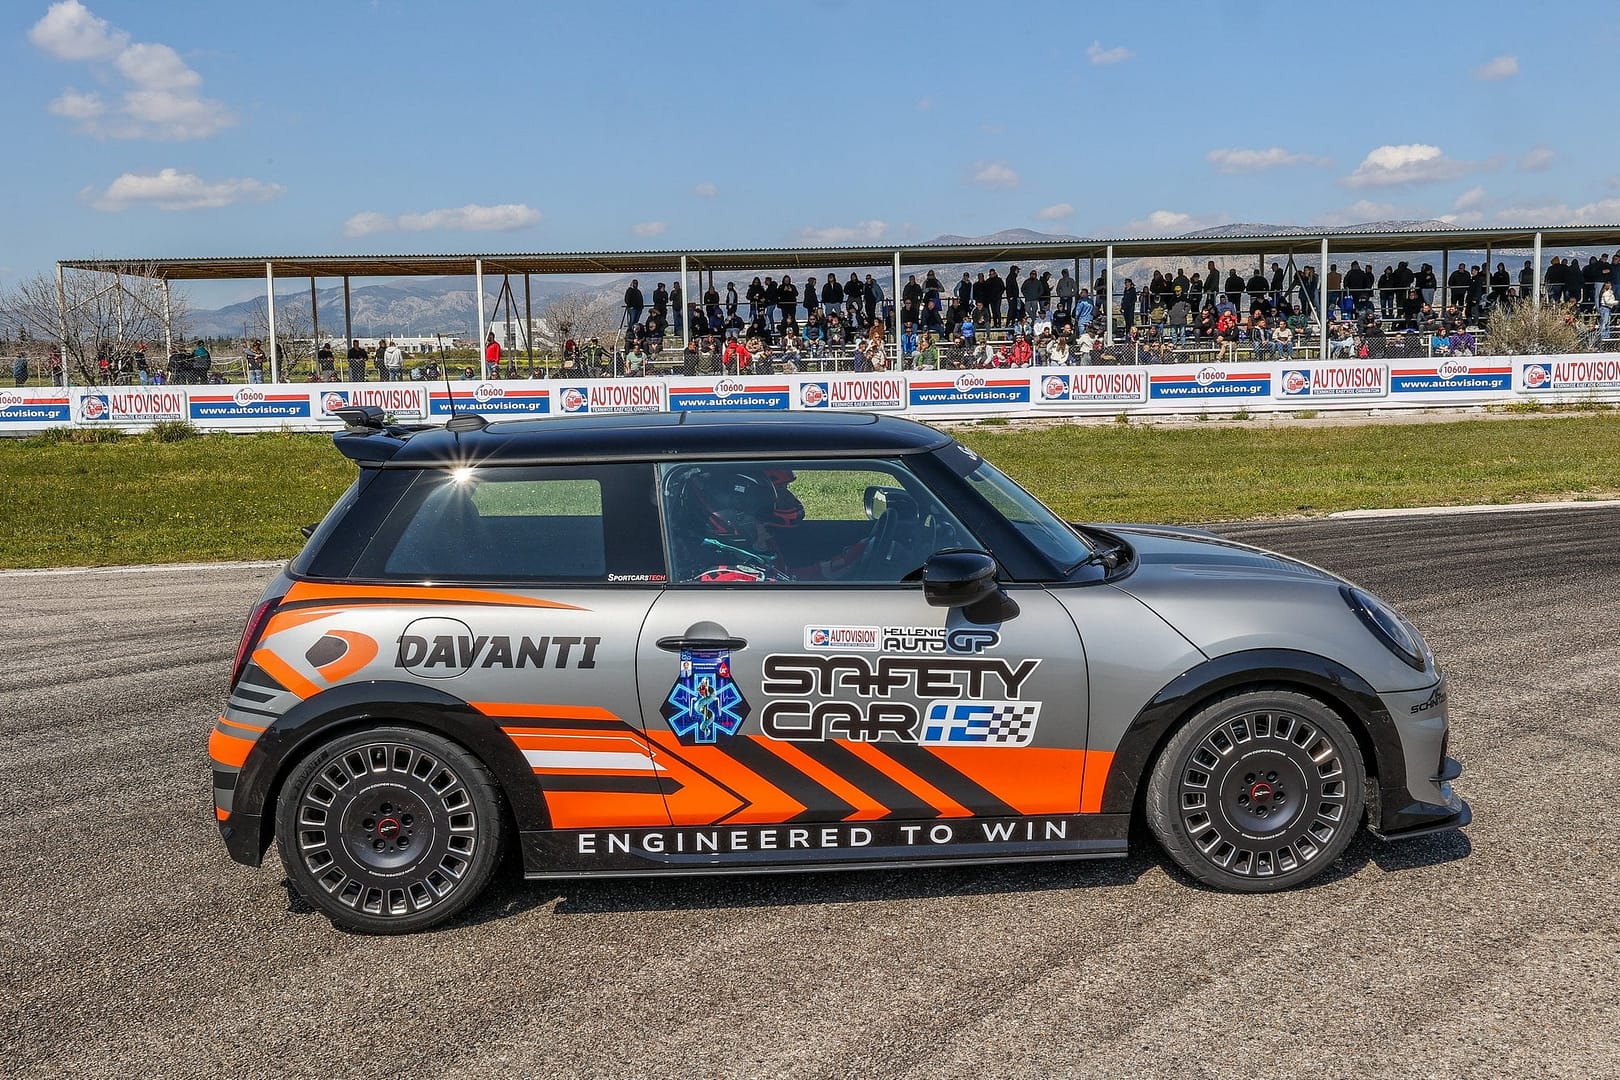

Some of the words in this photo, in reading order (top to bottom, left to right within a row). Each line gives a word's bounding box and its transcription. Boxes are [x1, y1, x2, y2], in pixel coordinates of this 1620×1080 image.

[1444, 366, 1468, 374] 10600
[1202, 372, 1226, 380] 10600
[1313, 368, 1382, 388] AUTOVISION
[719, 383, 744, 392] 10600
[961, 378, 985, 387] 10600
[1072, 374, 1141, 393] AUTOVISION
[1401, 378, 1504, 389] www.autovision.gr
[479, 388, 504, 397] 10600
[591, 386, 660, 405] AUTOVISION
[831, 380, 900, 400] AUTOVISION
[1160, 385, 1262, 395] www.autovision.gr
[239, 392, 264, 401] 10600
[352, 389, 421, 409] AUTOVISION
[919, 392, 1021, 402] www.autovision.gr
[112, 393, 181, 414] AUTOVISION
[679, 397, 781, 408] www.autovision.gr
[200, 406, 301, 416] www.autovision.gr
[830, 630, 875, 643] AUTOVISION
[884, 628, 947, 638] HELLENIC
[394, 635, 602, 669] DAVANTI
[762, 655, 1040, 699] SAFETY
[762, 701, 918, 741] CAR
[578, 827, 872, 854] ENGINEERED
[900, 824, 953, 845] TO
[981, 820, 1067, 842] WIN
